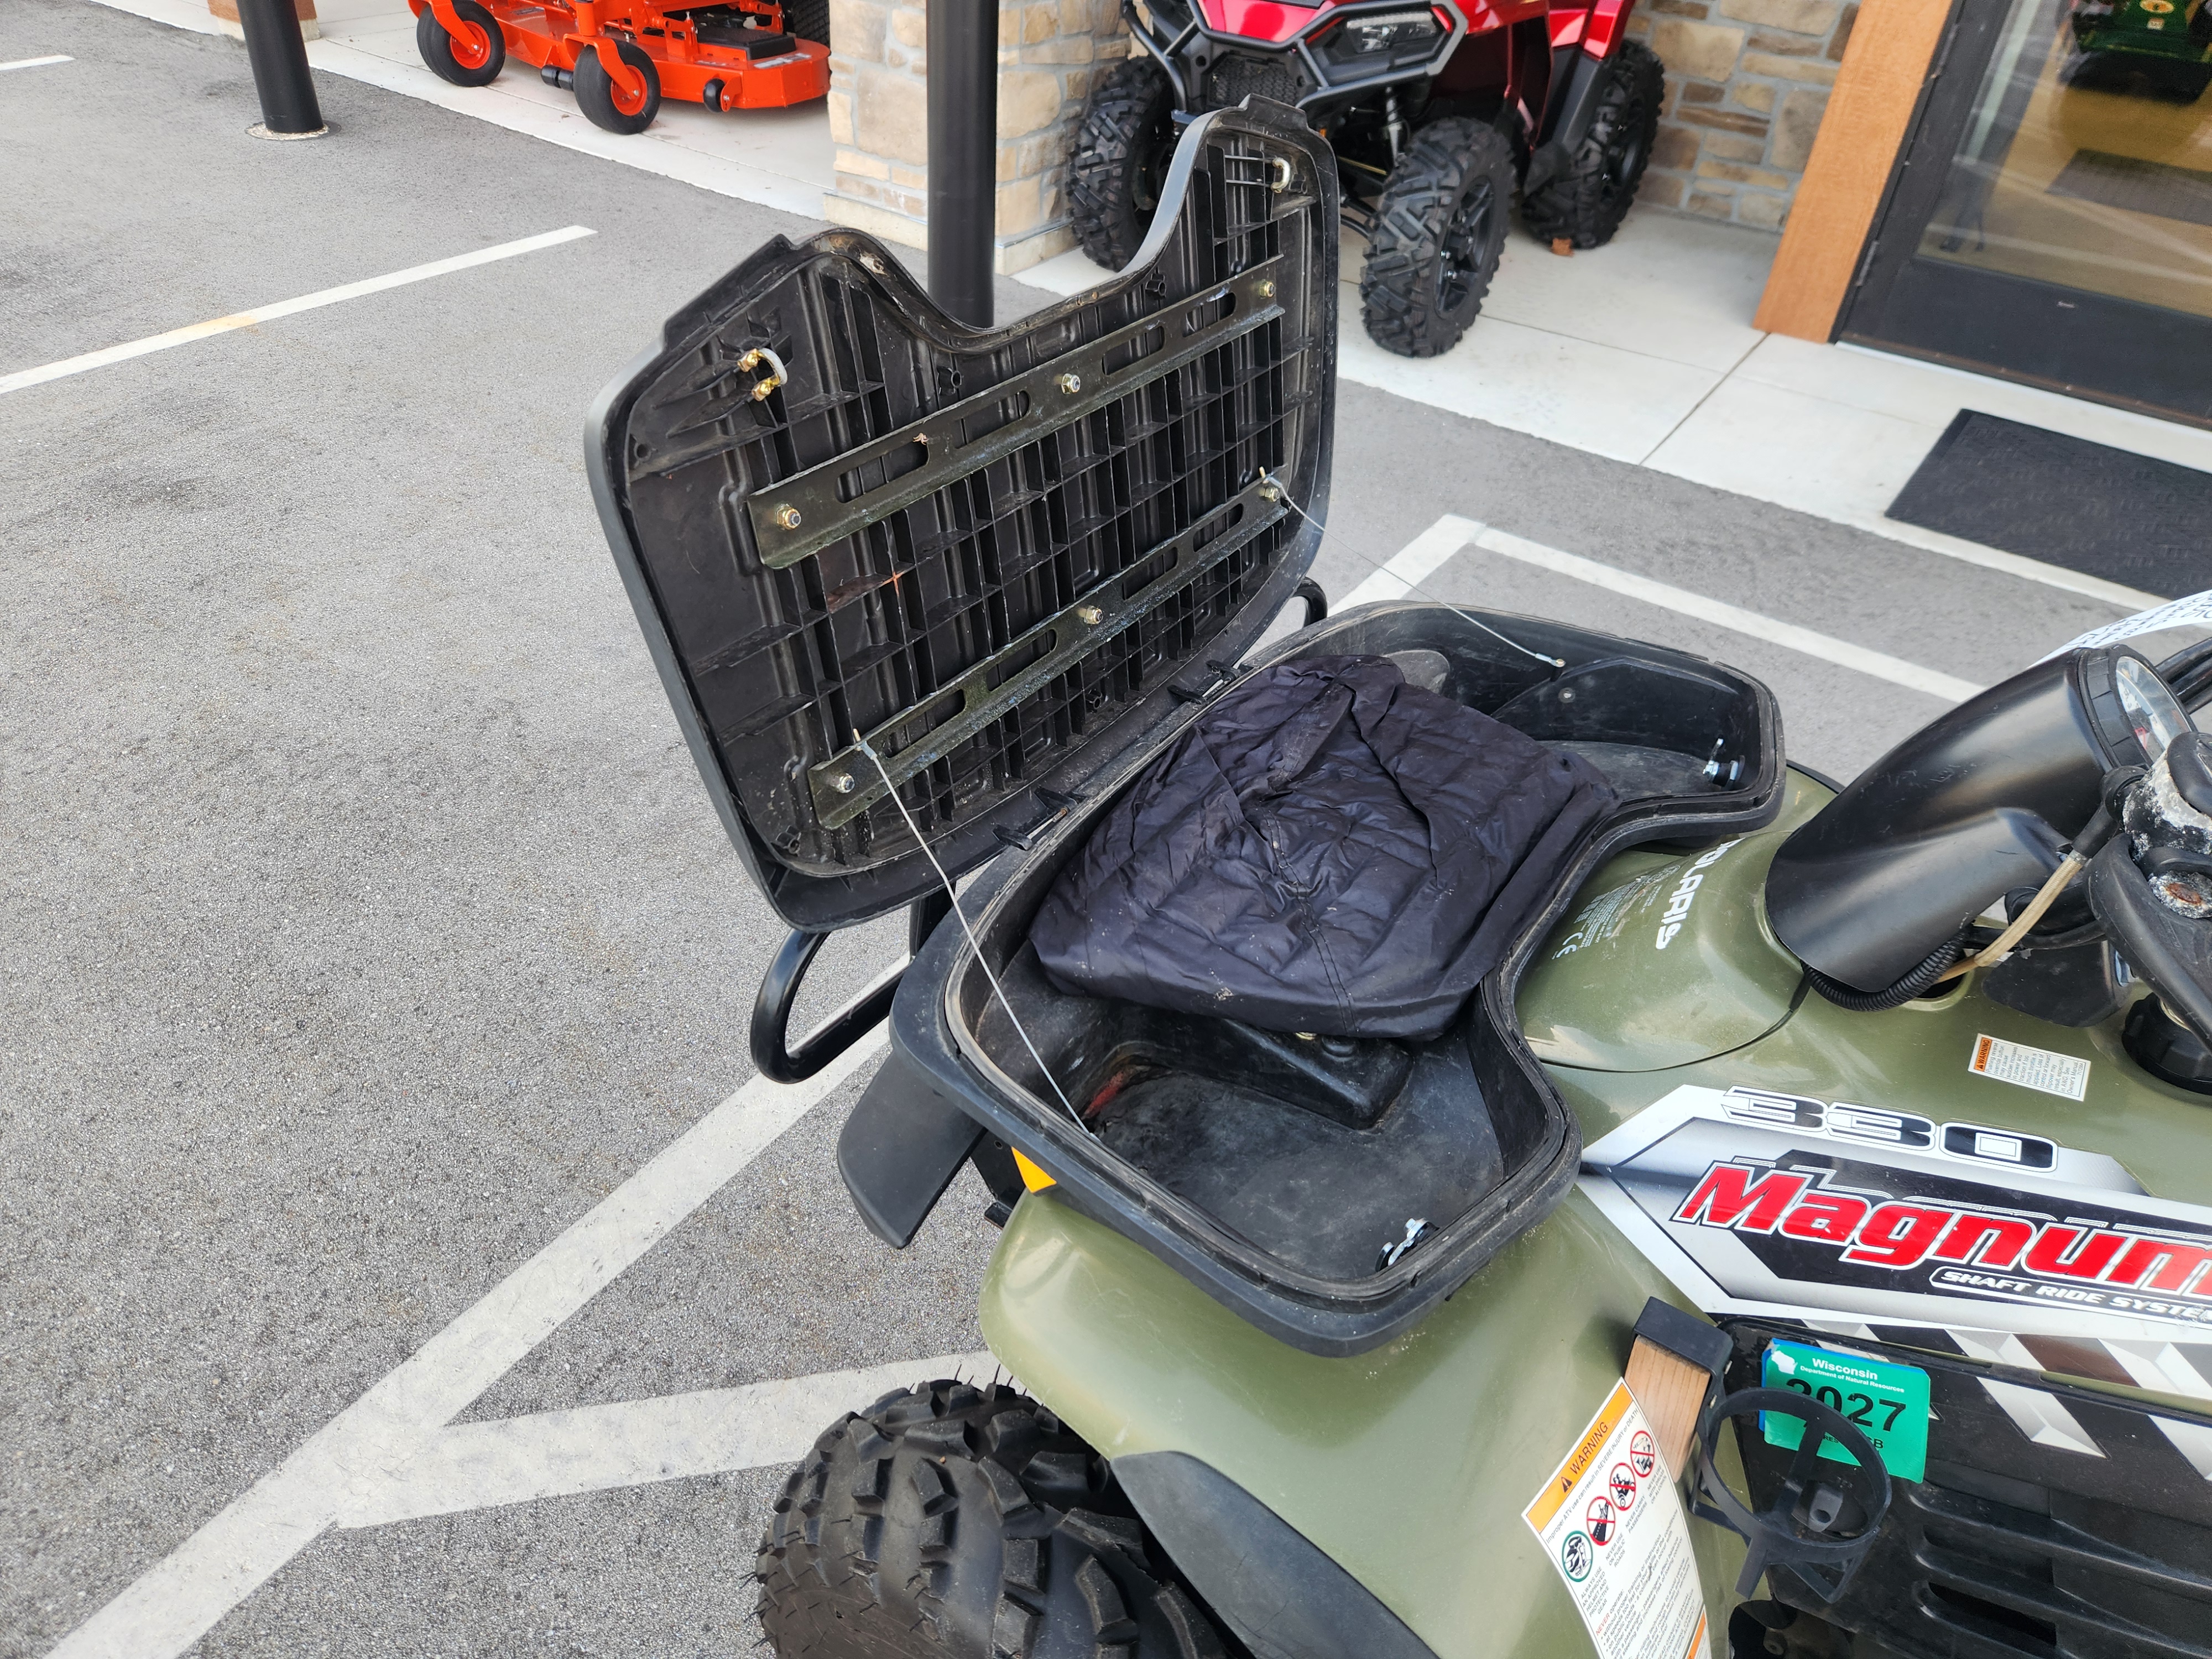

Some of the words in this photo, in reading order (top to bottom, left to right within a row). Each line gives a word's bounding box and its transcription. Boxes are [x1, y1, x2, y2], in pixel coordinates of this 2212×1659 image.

[1656, 837, 1746, 950] POLARIS
[1978, 1040, 1990, 1063] WARNING
[1985, 1057, 1995, 1072] Pushing
[2057, 1058, 2065, 1077] especially
[2067, 1077, 2075, 1093] Owner's
[1721, 1085, 2058, 1172] 330
[1673, 1160, 2212, 1297] Magnum
[1940, 1271, 2032, 1292] SHAFT
[2036, 1285, 2105, 1304] RIDE
[1801, 1365, 1837, 1379] Department
[1845, 1376, 1869, 1386] Natural
[1870, 1381, 1905, 1393] Resources
[1812, 1358, 1878, 1380] Wisconsin
[1570, 1422, 1608, 1474] WARNING
[1546, 1519, 1564, 1543] Improper
[1585, 1474, 1595, 1490] result
[1598, 1448, 1613, 1470] SEVERE
[1611, 1430, 1624, 1450] INJURY
[1626, 1408, 1638, 1427] DEATH
[1626, 1511, 1636, 1528] NEVER
[1635, 1495, 1645, 1512] CARRY
[1628, 1501, 1647, 1533] PASSENGERS
[1606, 1543, 1616, 1561] NEVER
[1609, 1557, 1614, 1566] ON
[1614, 1539, 1625, 1558] PUBLIC
[1614, 1549, 1625, 1567] ROADS
[1582, 1577, 1595, 1599] ALWAYS
[1587, 1590, 1599, 1611] HELMET
[1588, 1572, 1605, 1599] APPROVED
[1589, 1585, 1609, 1617] PROTECTIVE
[1603, 1614, 1617, 1636] without
[1617, 1594, 1628, 1615] proper
[1628, 1572, 1641, 1594] training
[1645, 1534, 1661, 1564] instruction
[1596, 1613, 1610, 1636] NEVER
[1610, 1589, 1624, 1614] operate:
[1598, 1599, 1607, 1614] GEAR
[1624, 1611, 1641, 1644] passenger
[1643, 1574, 1662, 1609] passengers
[1609, 1640, 1614, 1649] on
[1614, 1621, 1625, 1641] public
[1625, 1604, 1635, 1621] roads
[1610, 1614, 1623, 1636] speeds
[1611, 1632, 1624, 1656] another
[1625, 1610, 1636, 1631] vehicle
[1623, 1631, 1636, 1656] steering
[1642, 1594, 1656, 1619] increase
[1640, 1634, 1650, 1651] riding
[1650, 1602, 1666, 1634] techniques
